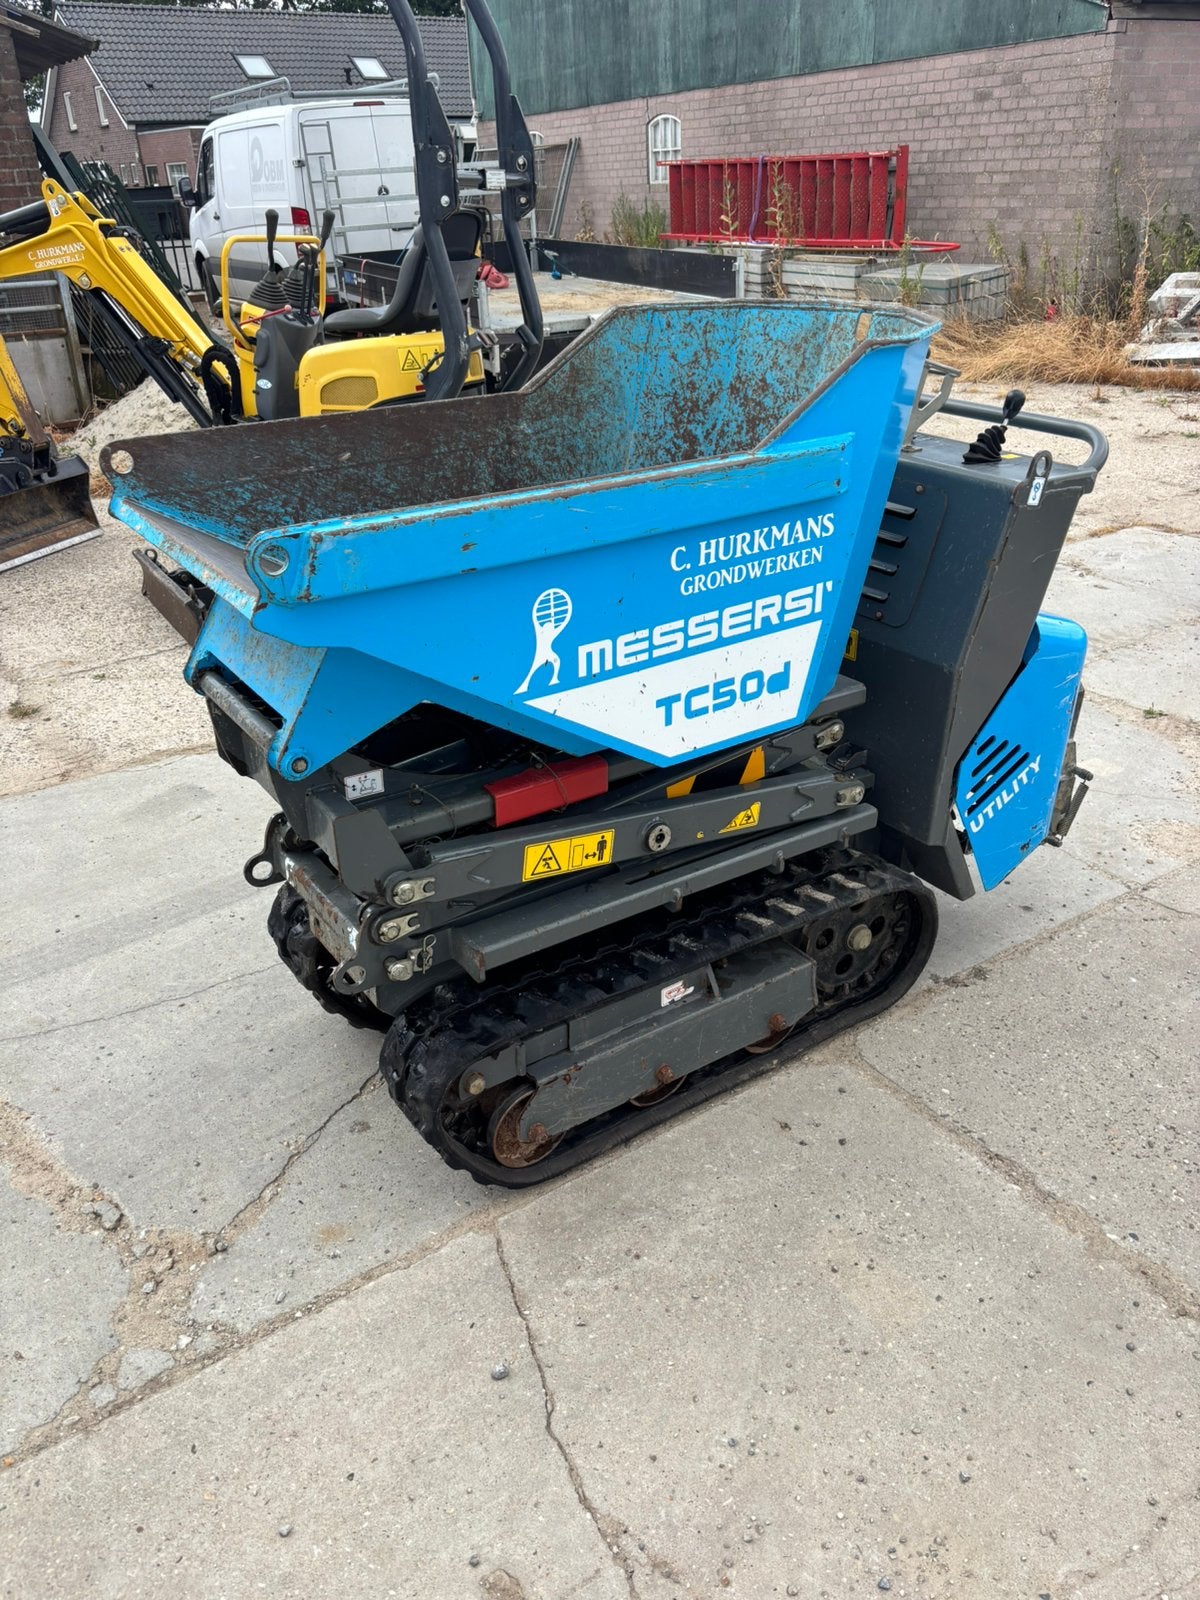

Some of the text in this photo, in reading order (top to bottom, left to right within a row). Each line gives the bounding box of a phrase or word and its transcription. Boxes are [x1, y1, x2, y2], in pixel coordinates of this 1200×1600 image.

[37, 241, 86, 260] HURKMANS
[670, 512, 836, 572] C. HURKMANS
[680, 545, 824, 596] GRONDWERKEN
[655, 660, 791, 727] TC50d
[969, 754, 1041, 833] UTILITY
